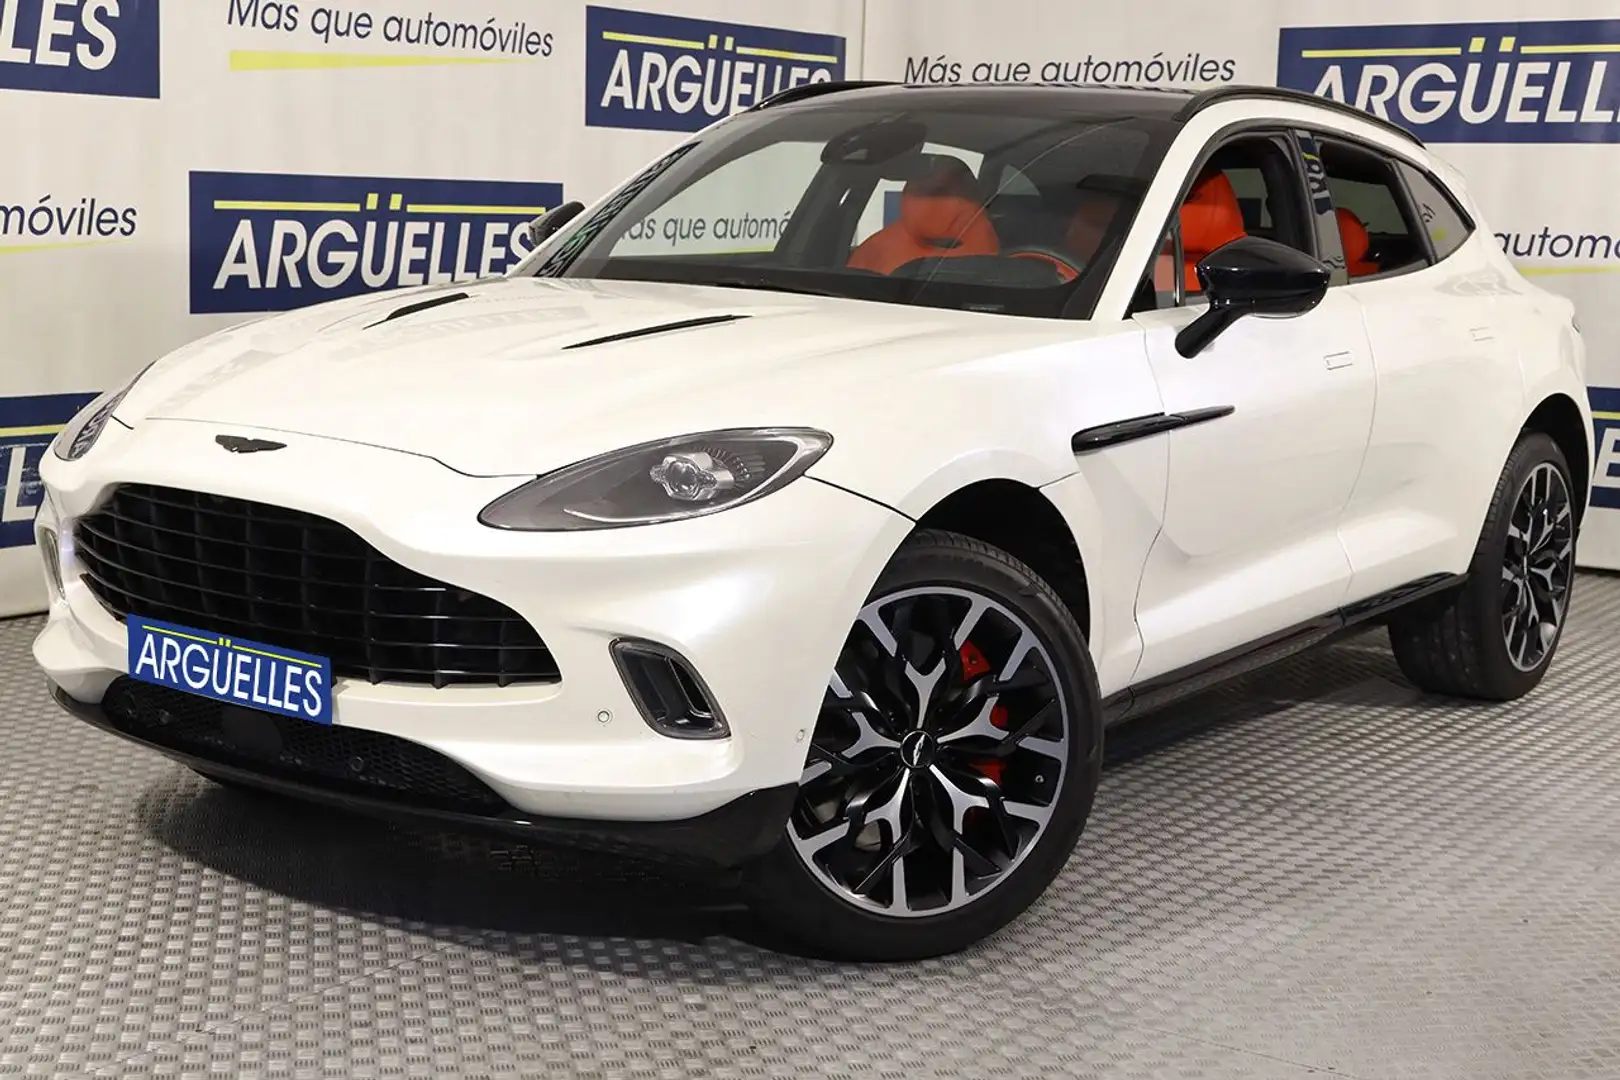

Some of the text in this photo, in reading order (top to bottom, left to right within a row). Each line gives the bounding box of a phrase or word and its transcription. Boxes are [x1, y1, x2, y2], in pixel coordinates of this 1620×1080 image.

[311, 7, 373, 44] que
[383, 12, 554, 57] automóviles
[904, 54, 961, 84] Más
[1040, 52, 1236, 83] automóviles
[1314, 36, 1620, 125] ARGÜELL
[663, 217, 706, 247] que
[134, 633, 323, 718] ARGÜELLES
